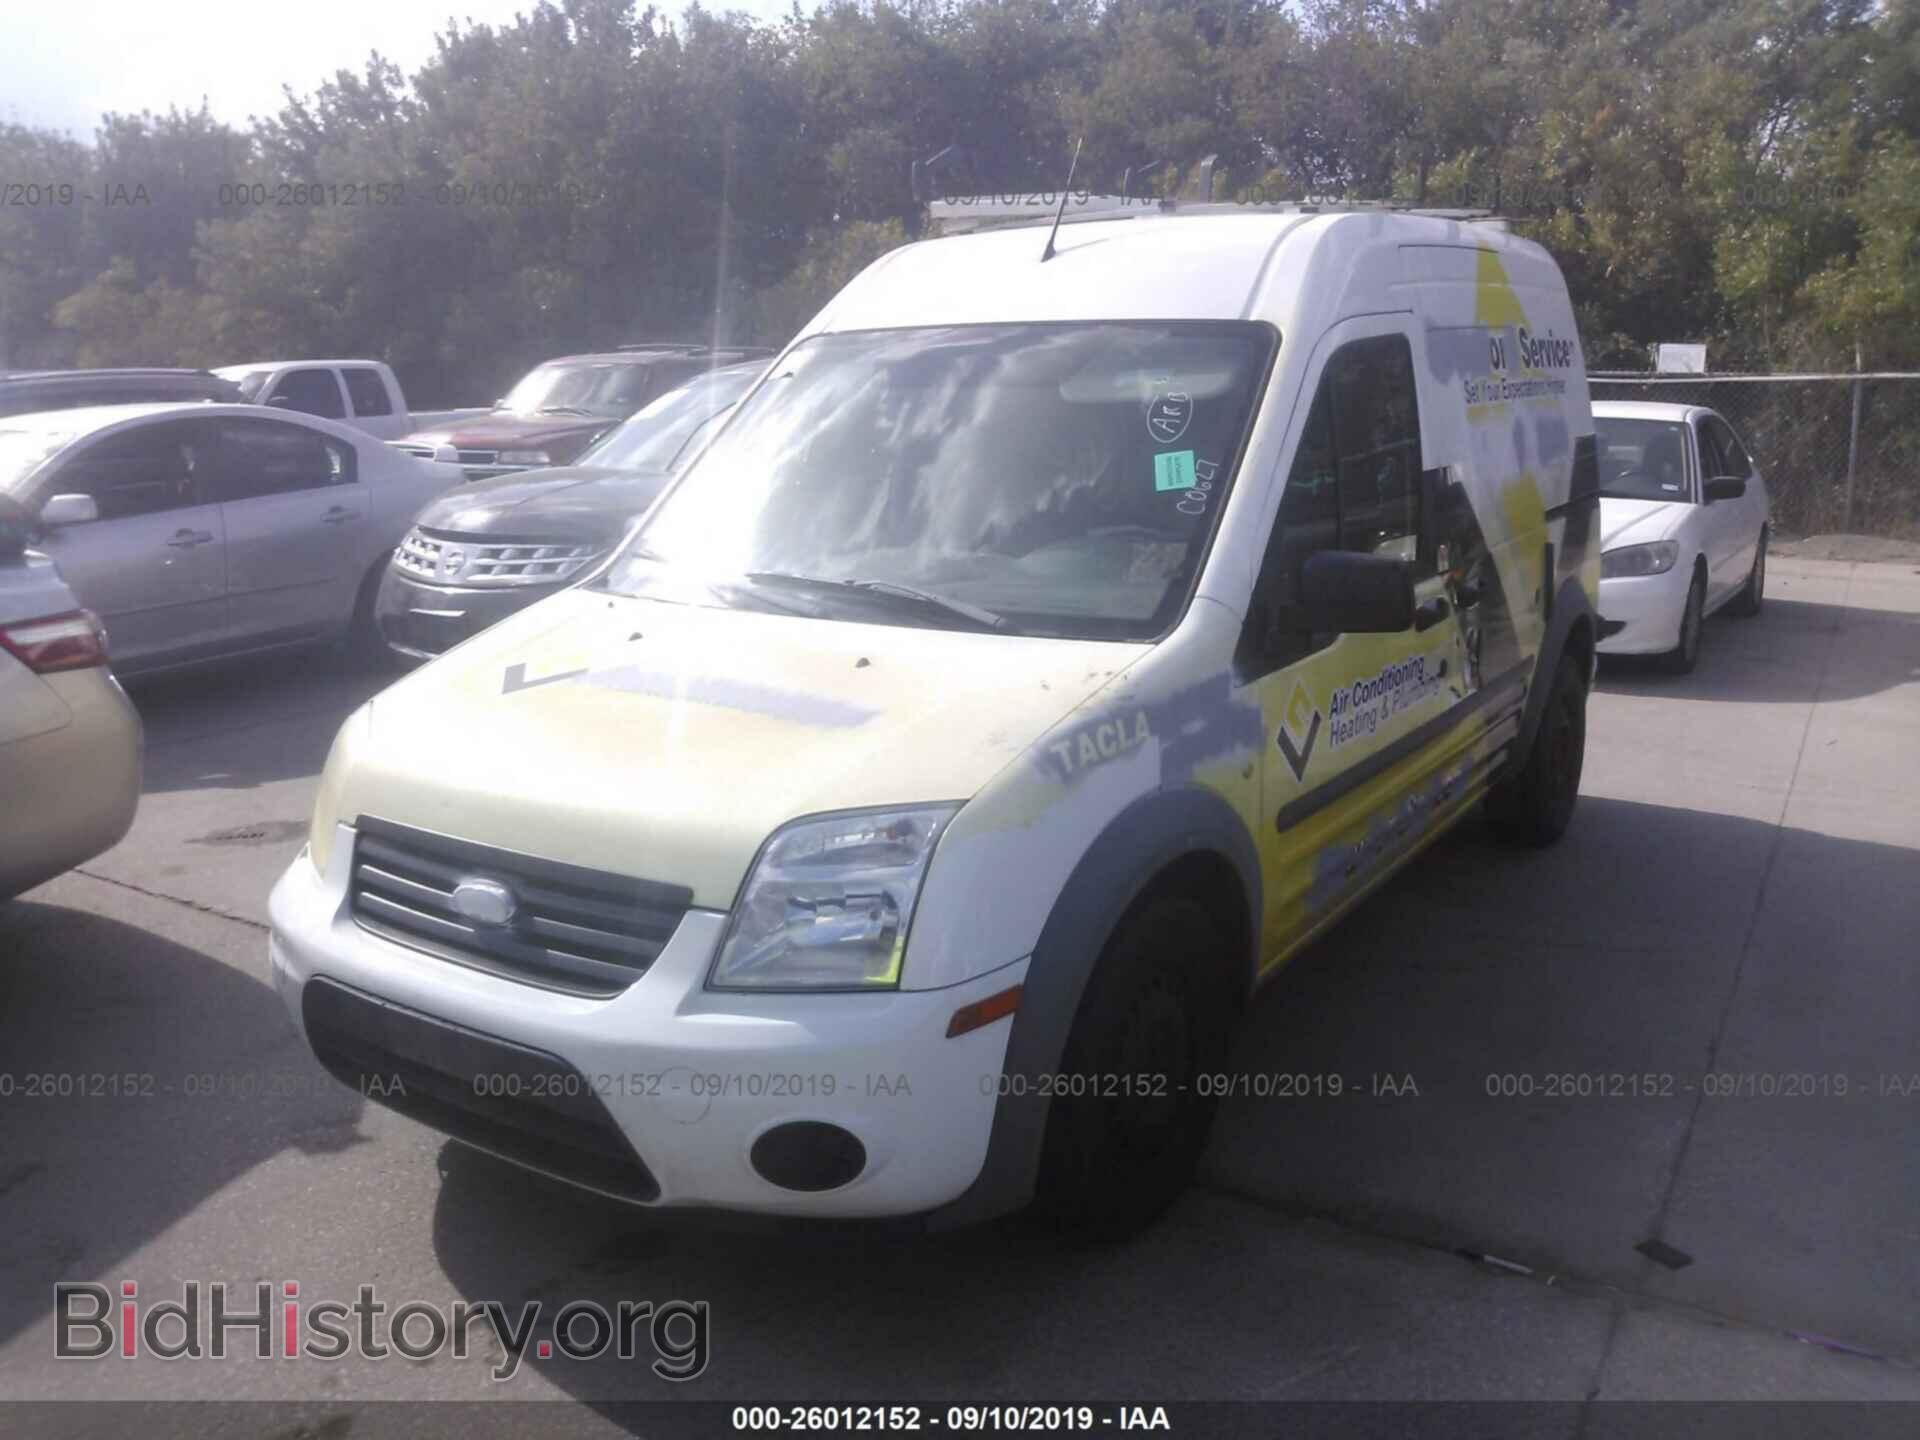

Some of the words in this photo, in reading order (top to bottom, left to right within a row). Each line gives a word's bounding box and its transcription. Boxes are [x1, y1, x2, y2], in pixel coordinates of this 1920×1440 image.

[1329, 688, 1349, 719] Air
[1352, 656, 1424, 706] Conditioning
[1329, 708, 1377, 747] Heating
